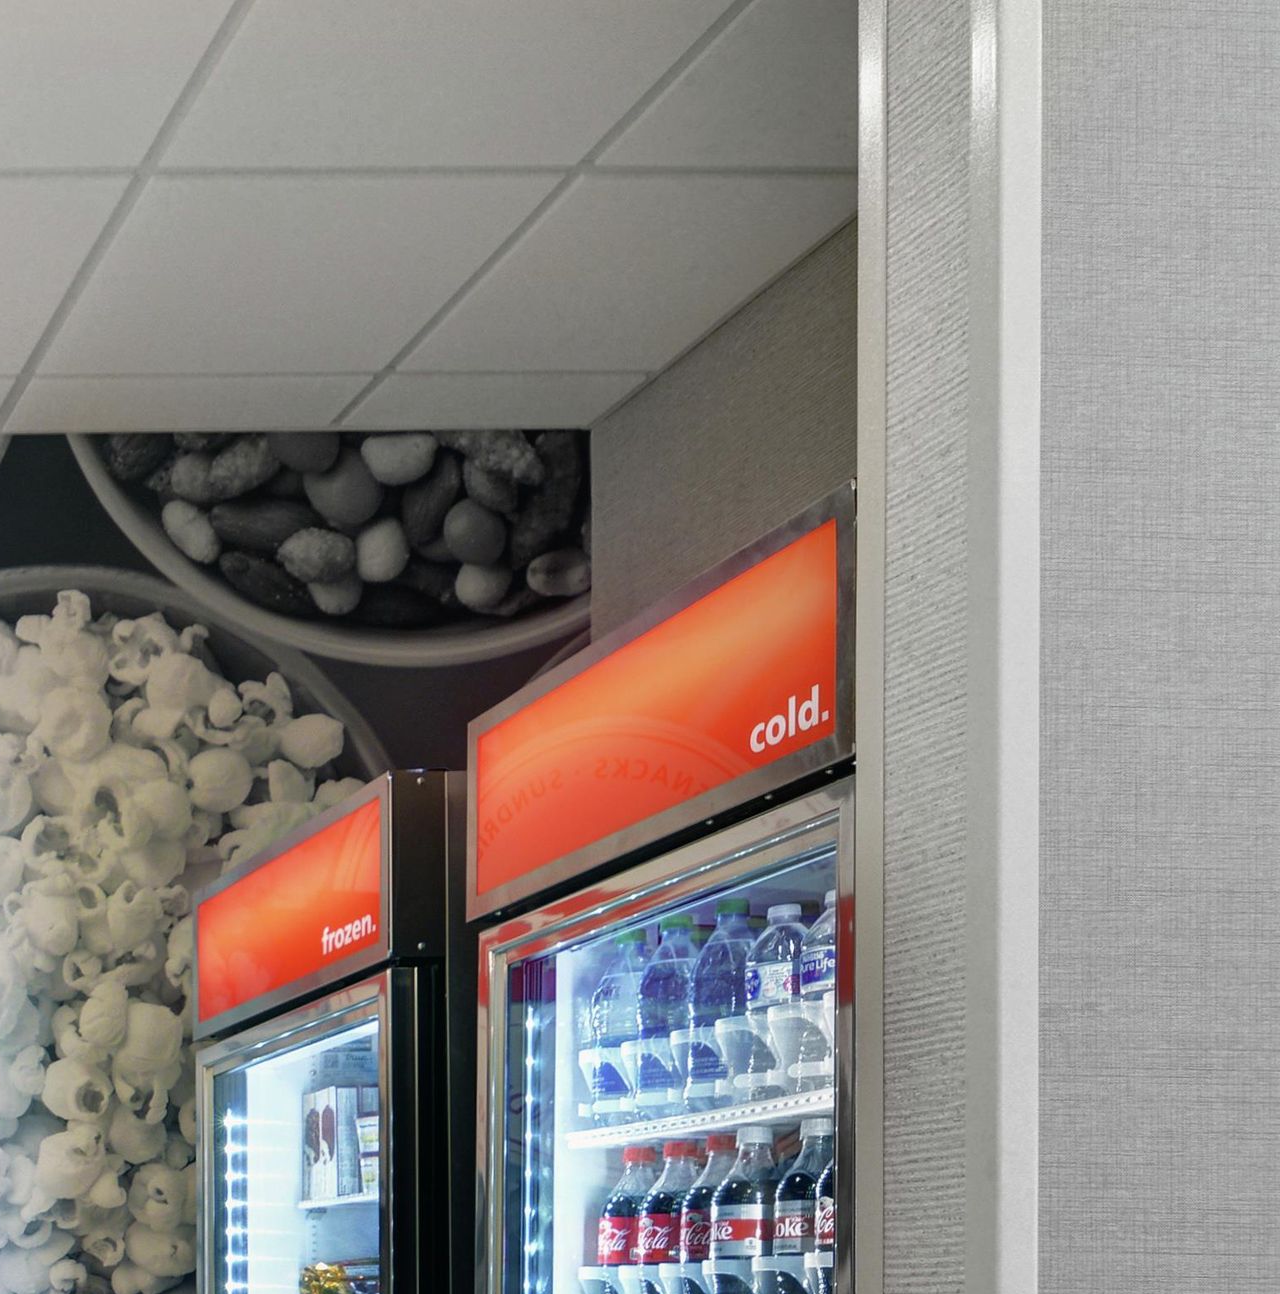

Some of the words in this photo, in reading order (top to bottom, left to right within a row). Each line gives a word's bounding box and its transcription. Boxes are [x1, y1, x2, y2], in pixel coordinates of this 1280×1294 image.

[750, 685, 830, 754] cold.
[322, 914, 377, 955] frozen.
[774, 1216, 809, 1238] oke
